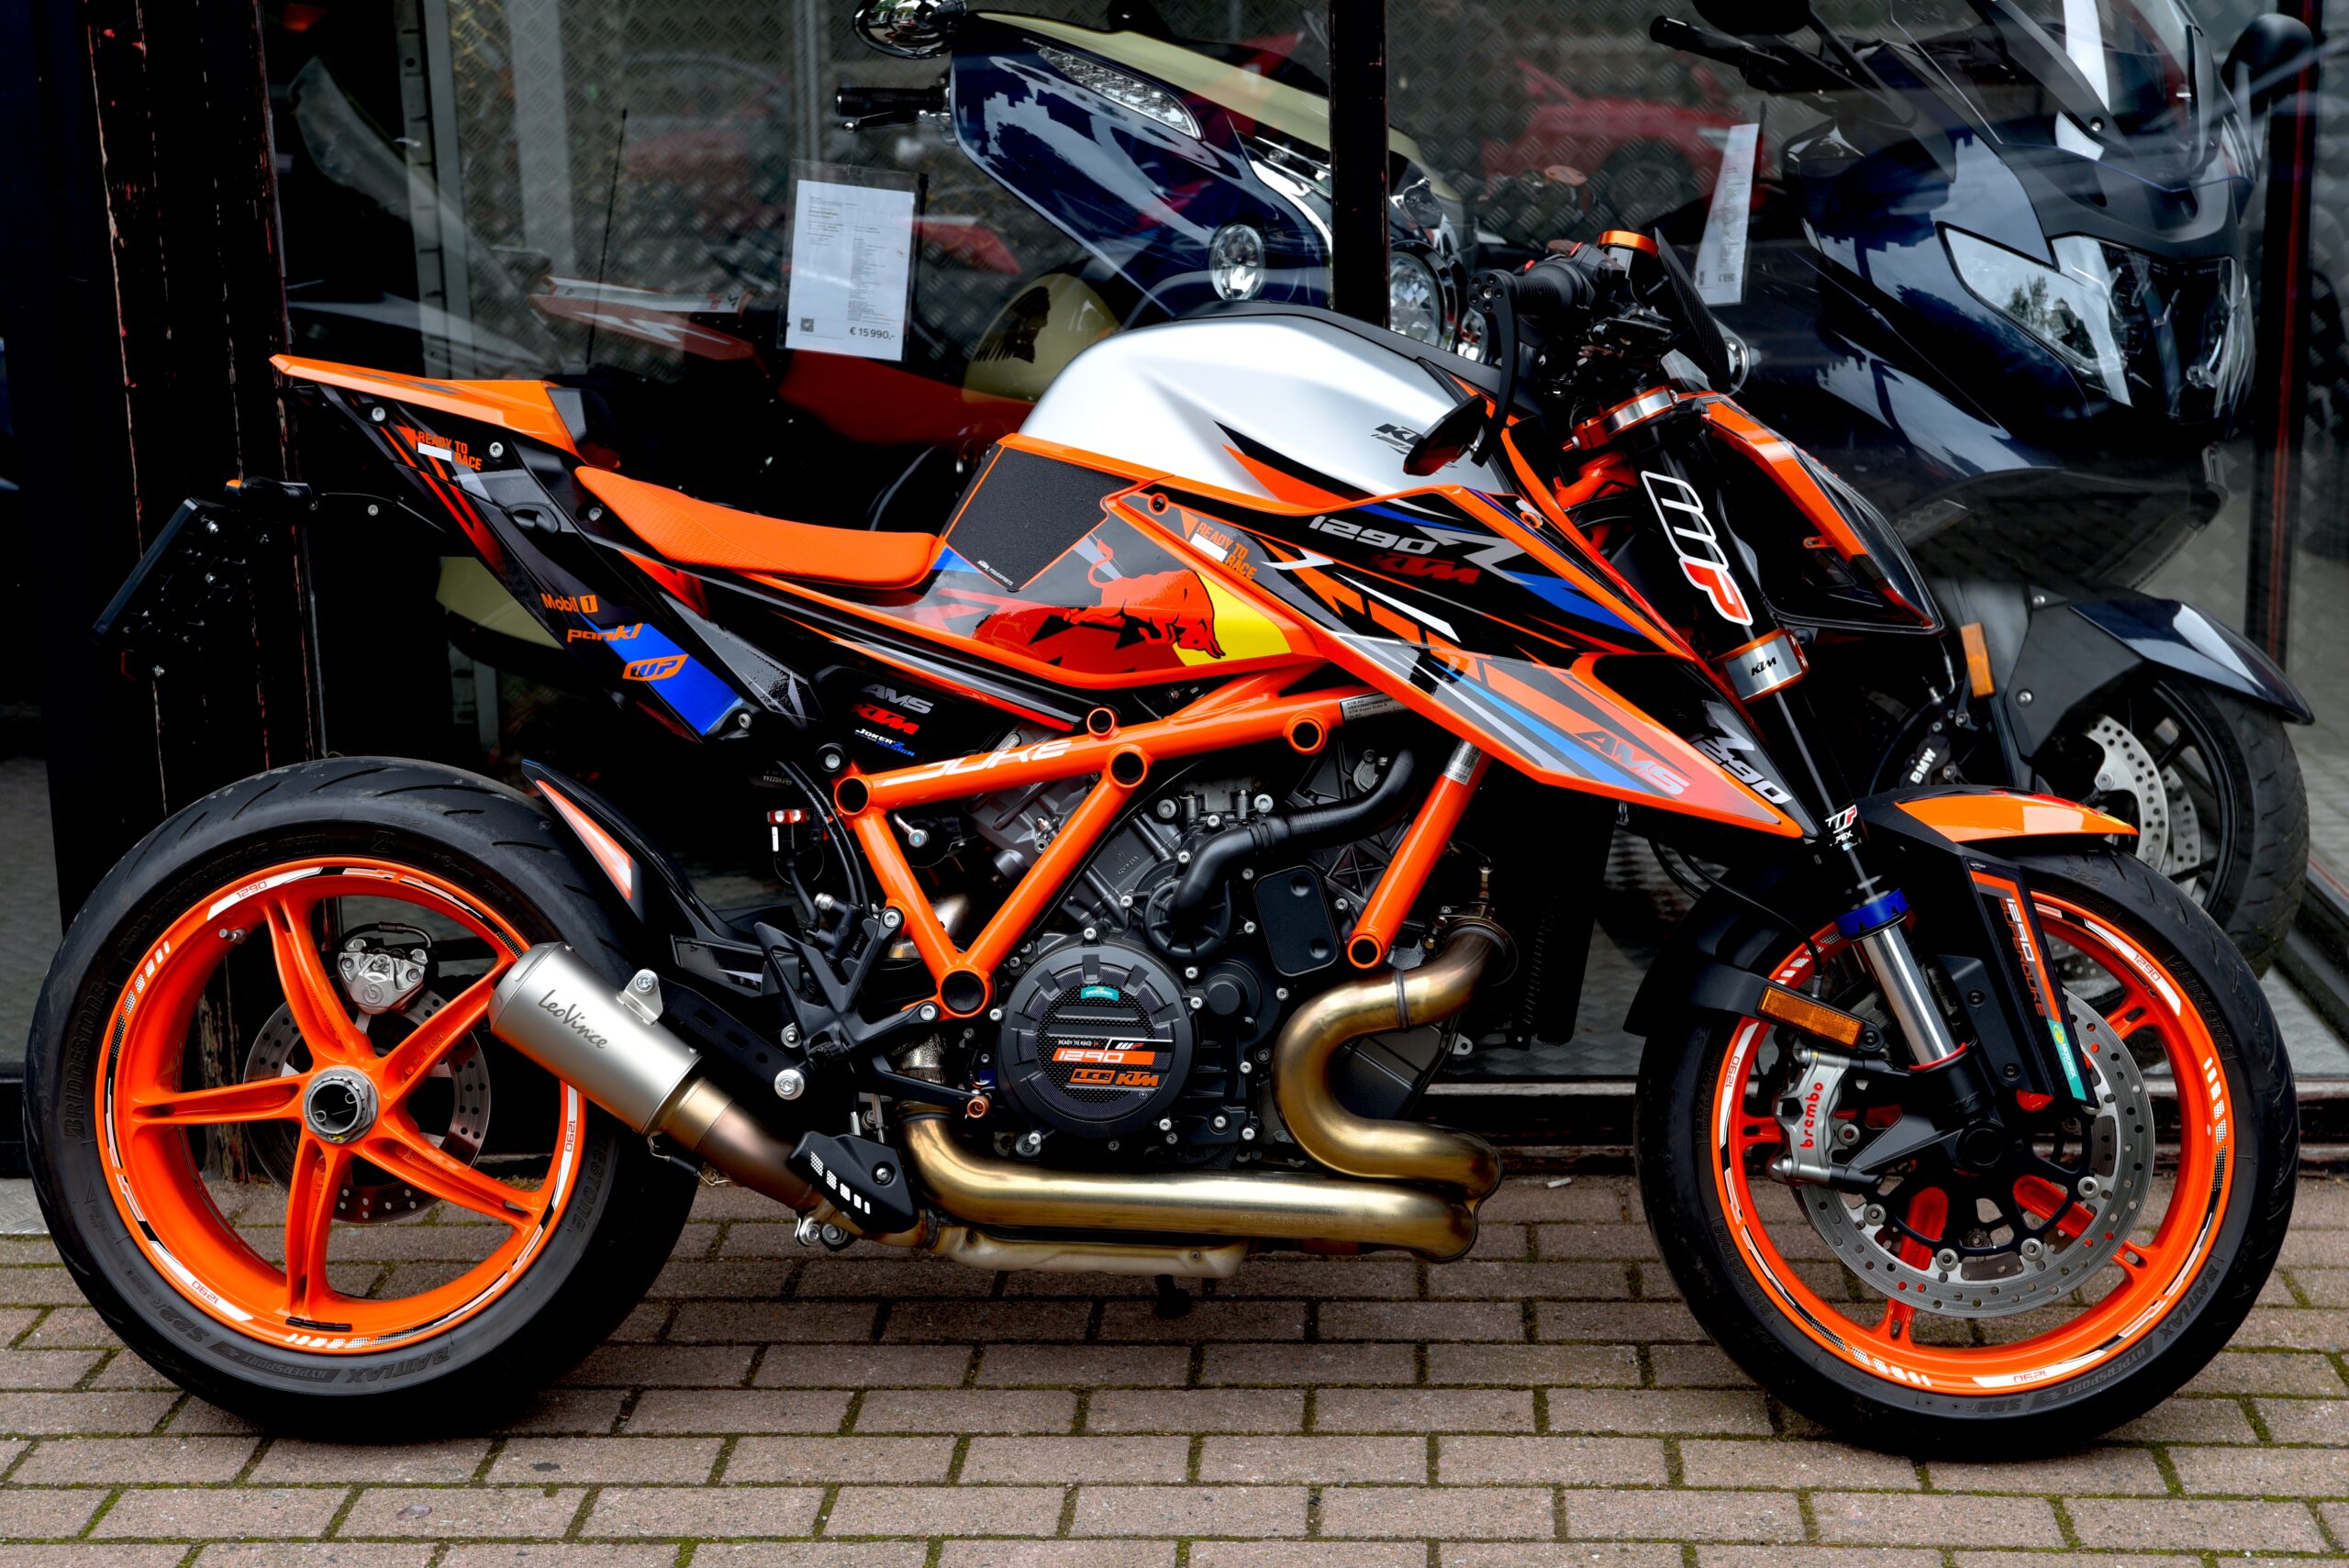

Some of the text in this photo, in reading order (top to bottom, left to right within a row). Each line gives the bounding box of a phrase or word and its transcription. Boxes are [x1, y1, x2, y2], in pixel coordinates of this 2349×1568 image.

[850, 327, 856, 336] €
[417, 430, 469, 455] READY TO
[454, 452, 483, 471] RACE
[1197, 520, 1249, 561] READY TO
[1308, 515, 1439, 555] 1290
[1224, 553, 1258, 580] RACE
[1367, 551, 1481, 585] KTM
[540, 593, 581, 614] Mobil
[567, 622, 643, 643] pankl
[1750, 656, 1778, 677] KTM
[863, 683, 934, 714] AMS
[851, 703, 920, 736] KTM
[879, 740, 1073, 787] DUKE
[1575, 730, 1690, 795] AMS
[1685, 733, 1793, 805] 1290
[1909, 747, 1937, 784] BMW
[236, 881, 268, 899] 1290
[2006, 897, 2036, 962] 1290
[2132, 953, 2161, 982] 1290
[538, 989, 607, 1049] LeoVince
[1058, 1050, 1125, 1063] 1290
[1724, 1055, 1741, 1088] 1290
[1115, 1071, 1161, 1087] KTM
[1799, 1082, 1824, 1149] brembo
[565, 1119, 576, 1152] 1290
[191, 1280, 220, 1306] 1290
[2158, 1263, 2221, 1341] BATTLAX
[243, 1354, 329, 1379] HYPERSPORT
[345, 1345, 451, 1384] BATTLAX
[2012, 1370, 2047, 1384] 1290
[2066, 1347, 2147, 1396] HYPERSPORT
